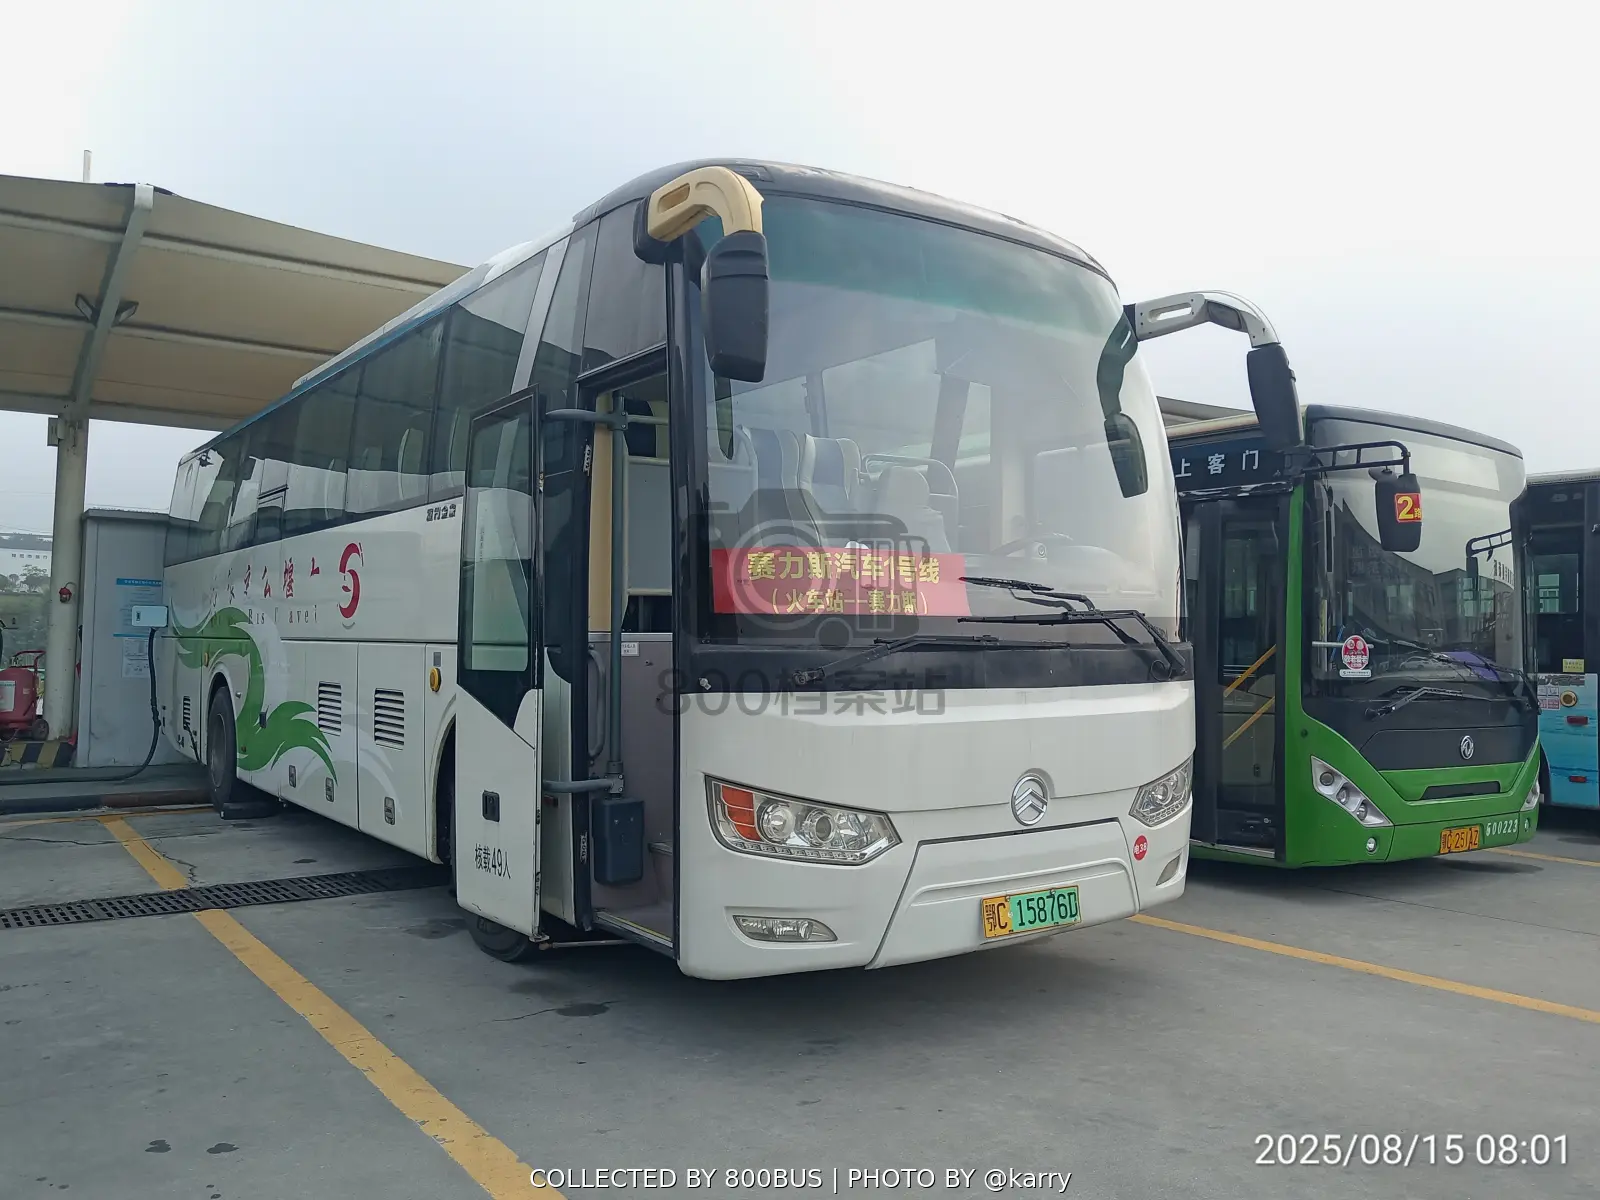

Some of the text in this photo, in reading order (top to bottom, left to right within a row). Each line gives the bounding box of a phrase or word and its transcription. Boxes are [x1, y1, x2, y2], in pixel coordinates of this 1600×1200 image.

[1175, 449, 1259, 478] 上客门
[747, 552, 940, 584] 赛力斯汽车1号线
[474, 842, 512, 880] 核载49人
